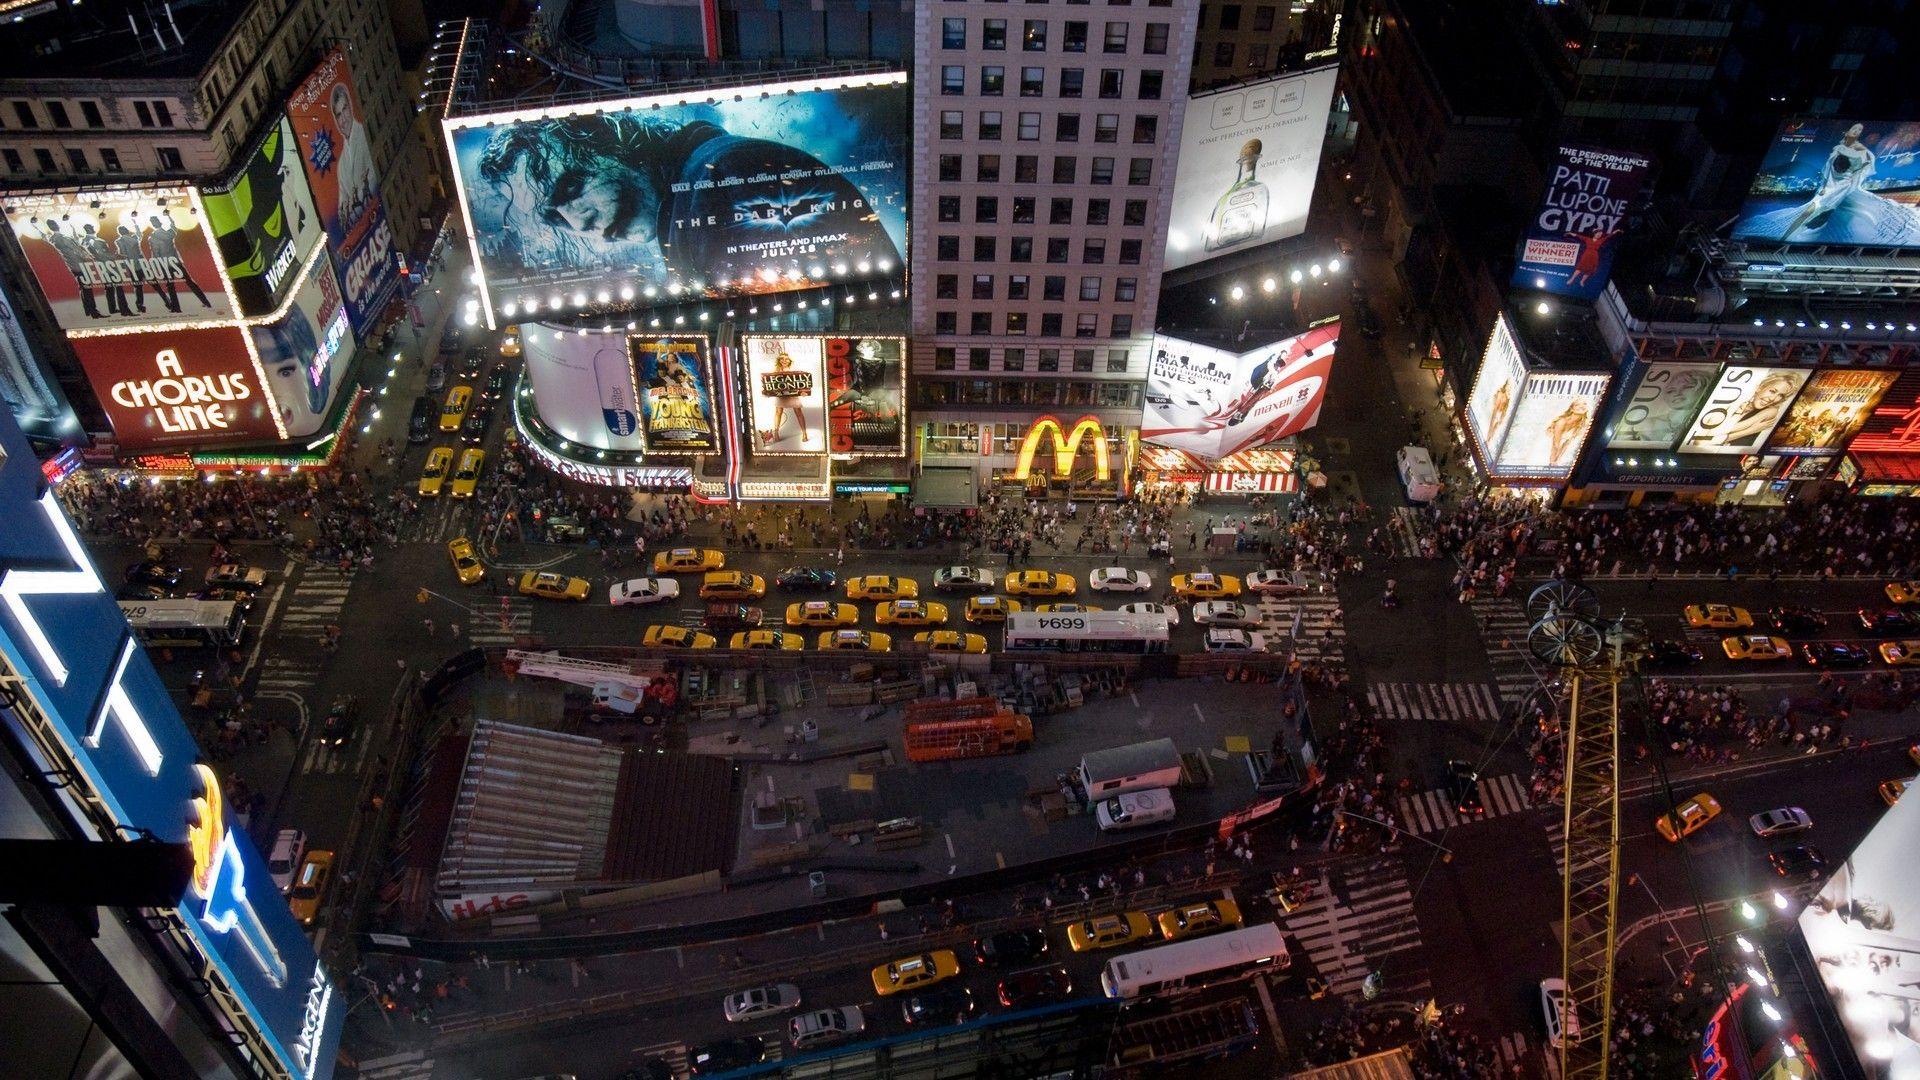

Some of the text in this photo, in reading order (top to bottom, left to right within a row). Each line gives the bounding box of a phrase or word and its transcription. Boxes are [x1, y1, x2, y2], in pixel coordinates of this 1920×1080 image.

[1199, 136, 1217, 145] SOME
[1220, 125, 1263, 141] PERFECTION
[1559, 147, 1649, 167] THE PERFORMANCE
[1569, 156, 1633, 172] OF THE YEAR!
[672, 162, 894, 193] BALE CAINE LEDGER OLDMAN ECKHART GYLLENHAAL FREEMAN
[1553, 165, 1611, 194] PATTI
[675, 195, 894, 229] THE DARK KNIGHT
[1539, 209, 1623, 233] GYPSY
[727, 233, 848, 254] IN THEATERS AND IMAX
[761, 244, 816, 259] JULY 18
[1528, 247, 1576, 258] WINNER!
[79, 256, 184, 284] JERSEY BOYS
[265, 239, 297, 293] WICKED
[346, 219, 391, 303] GREASE
[155, 349, 184, 377] A
[1157, 355, 1231, 381] MAXIMUM
[764, 374, 811, 383] LEGALLY
[766, 380, 812, 391] BLONDE
[1154, 368, 1196, 385] LIVES
[1155, 363, 1230, 386] PERFORMANCE
[111, 373, 250, 408] CHORUS
[1834, 394, 1867, 403] MUSICAL
[651, 398, 703, 420] YOUNG
[1254, 396, 1293, 417] maxell
[1686, 368, 1753, 447] TOUS
[154, 403, 228, 433] LINE
[652, 418, 710, 431] FRANKENSTEIN
[1618, 475, 1696, 483] OPPORTUNITY
[1039, 617, 1085, 630] 6694
[292, 958, 326, 1072] ARGENT
